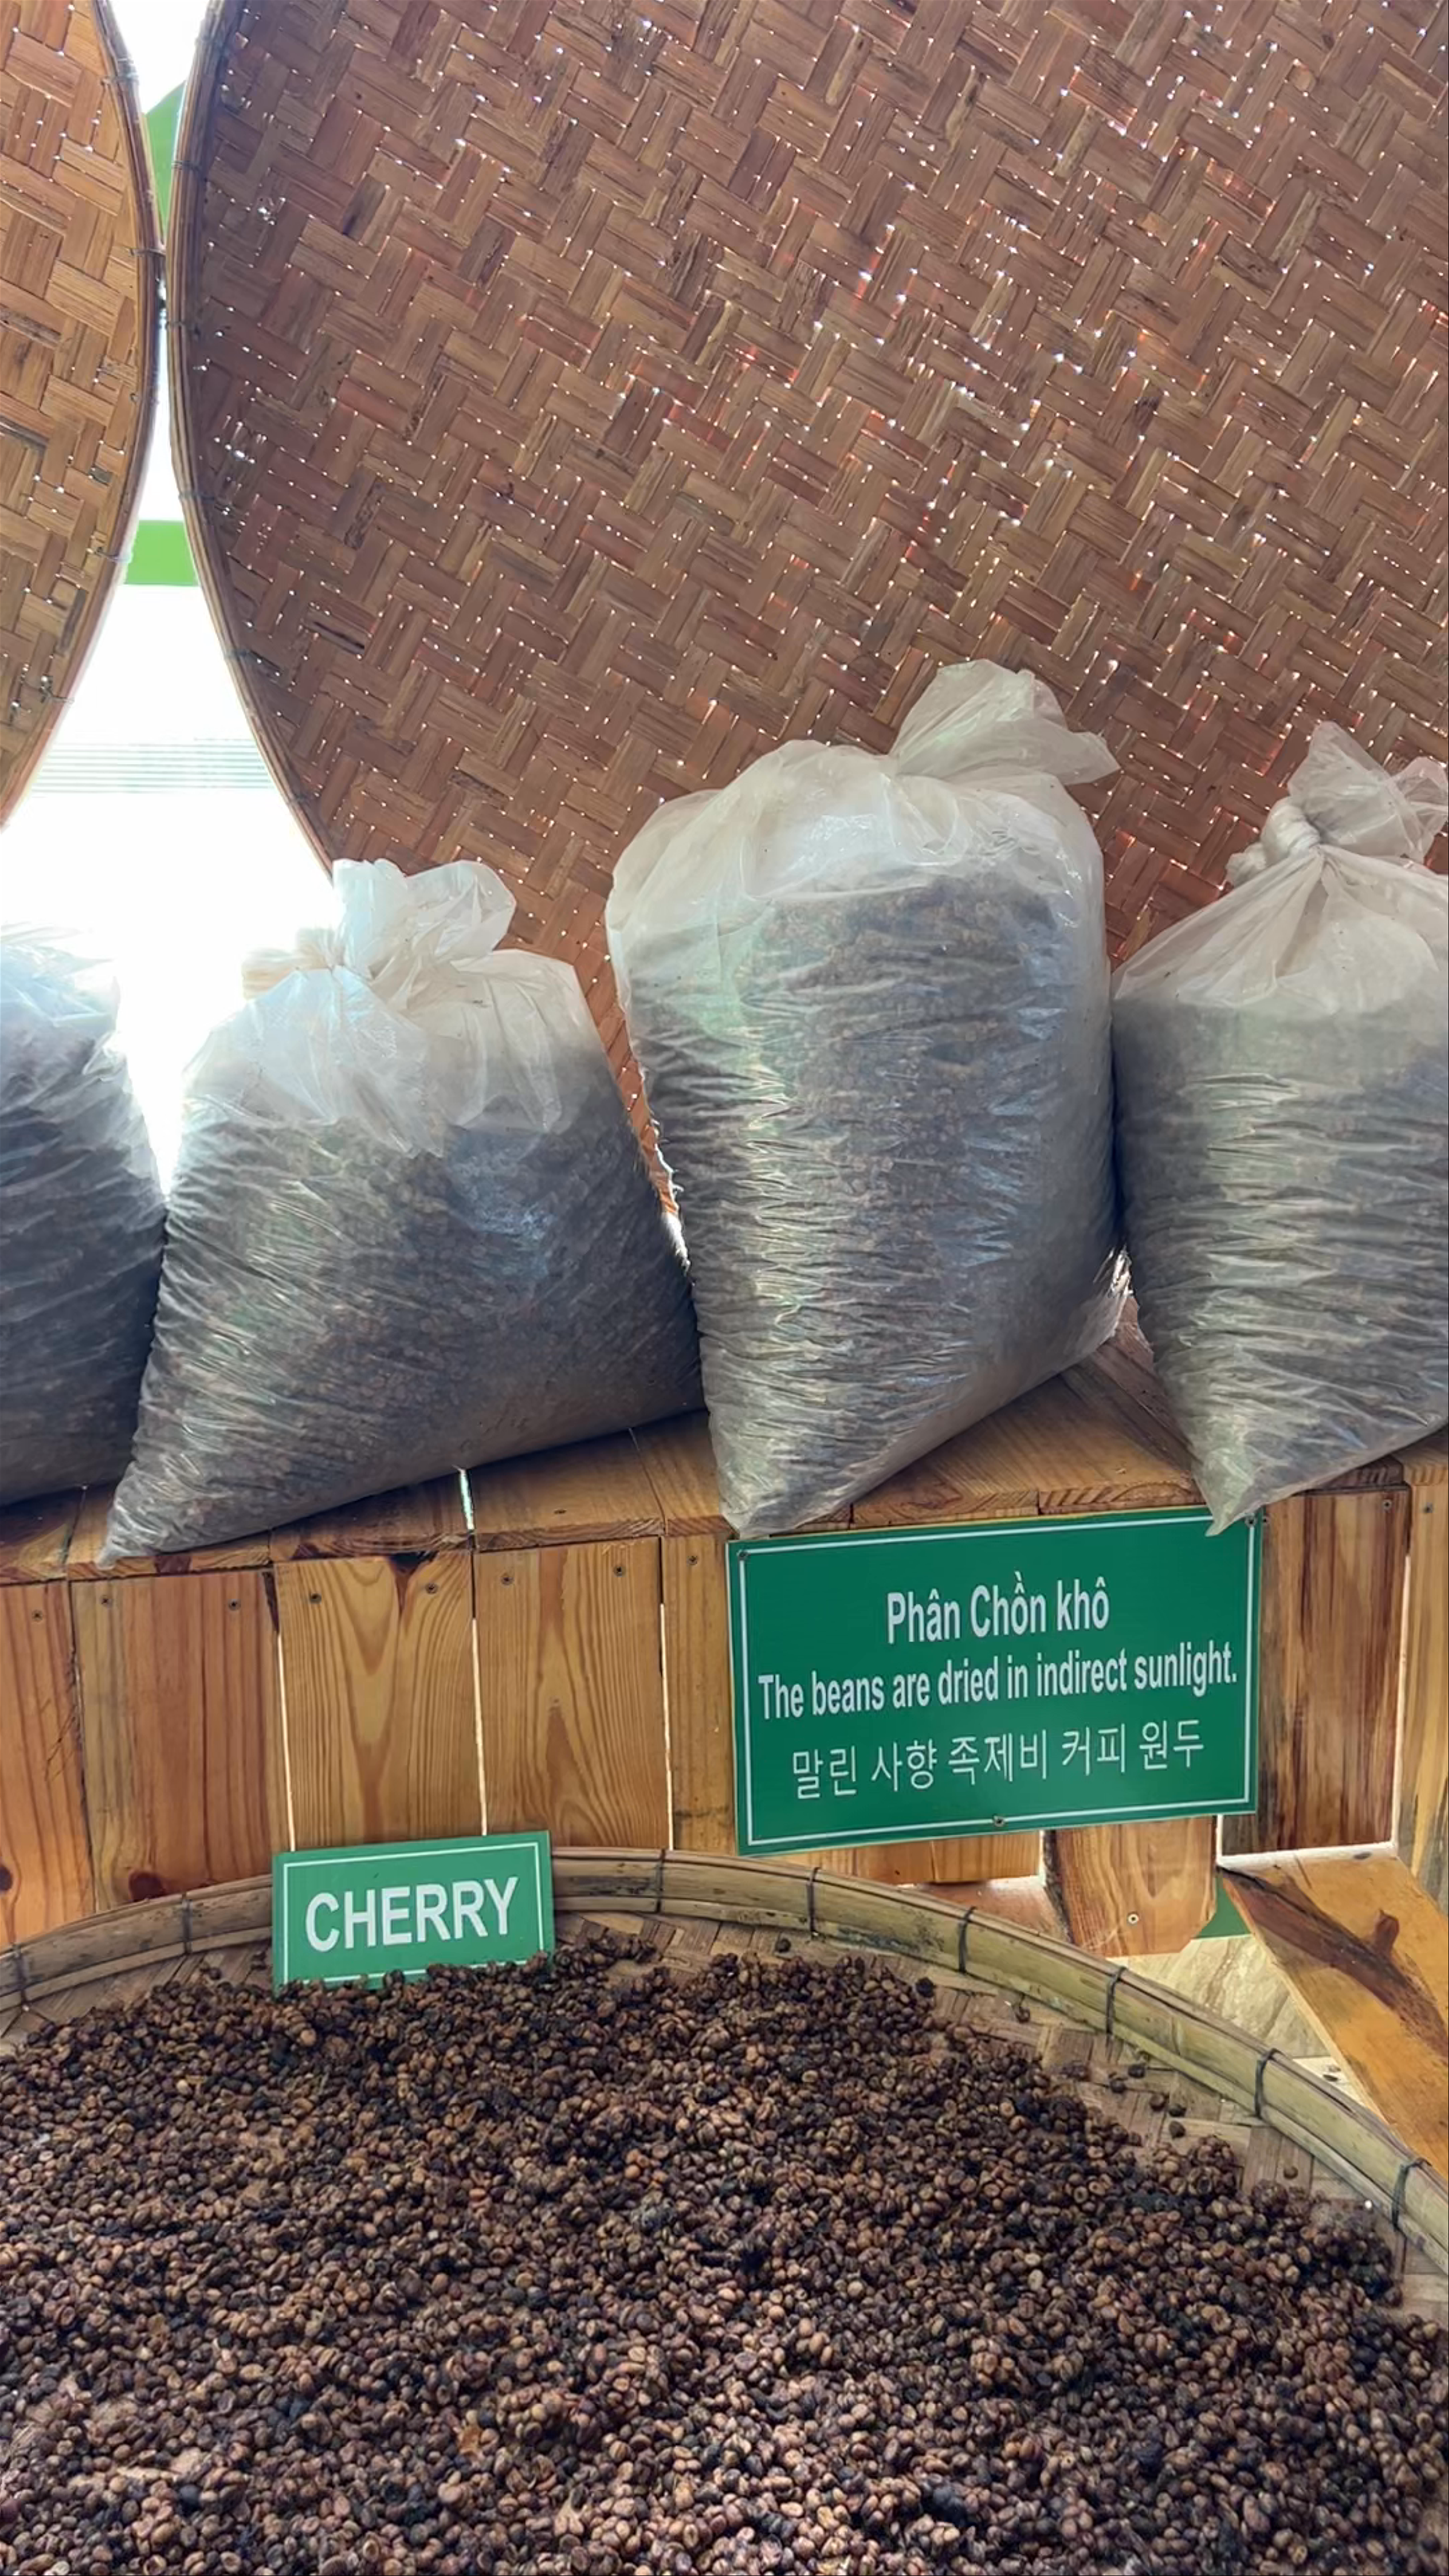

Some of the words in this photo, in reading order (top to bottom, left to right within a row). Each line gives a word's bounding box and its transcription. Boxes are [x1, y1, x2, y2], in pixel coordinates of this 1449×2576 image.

[888, 1589, 960, 1644] Phân
[971, 1571, 1046, 1638] Chồn
[1057, 1576, 1109, 1631] khô
[758, 1674, 804, 1719] The
[812, 1671, 884, 1715] beans
[893, 1673, 930, 1708] are
[938, 1656, 998, 1705] dried
[1008, 1655, 1028, 1699] in
[1037, 1649, 1127, 1696] indirect
[1134, 1640, 1237, 1697] sunlight.
[793, 1746, 856, 1799] 말린
[871, 1739, 937, 1792] 사향
[948, 1730, 1046, 1785] 족제비
[1062, 1724, 1125, 1776] 커피
[1139, 1720, 1203, 1770] 원두
[305, 1877, 518, 1952] CHERRY
